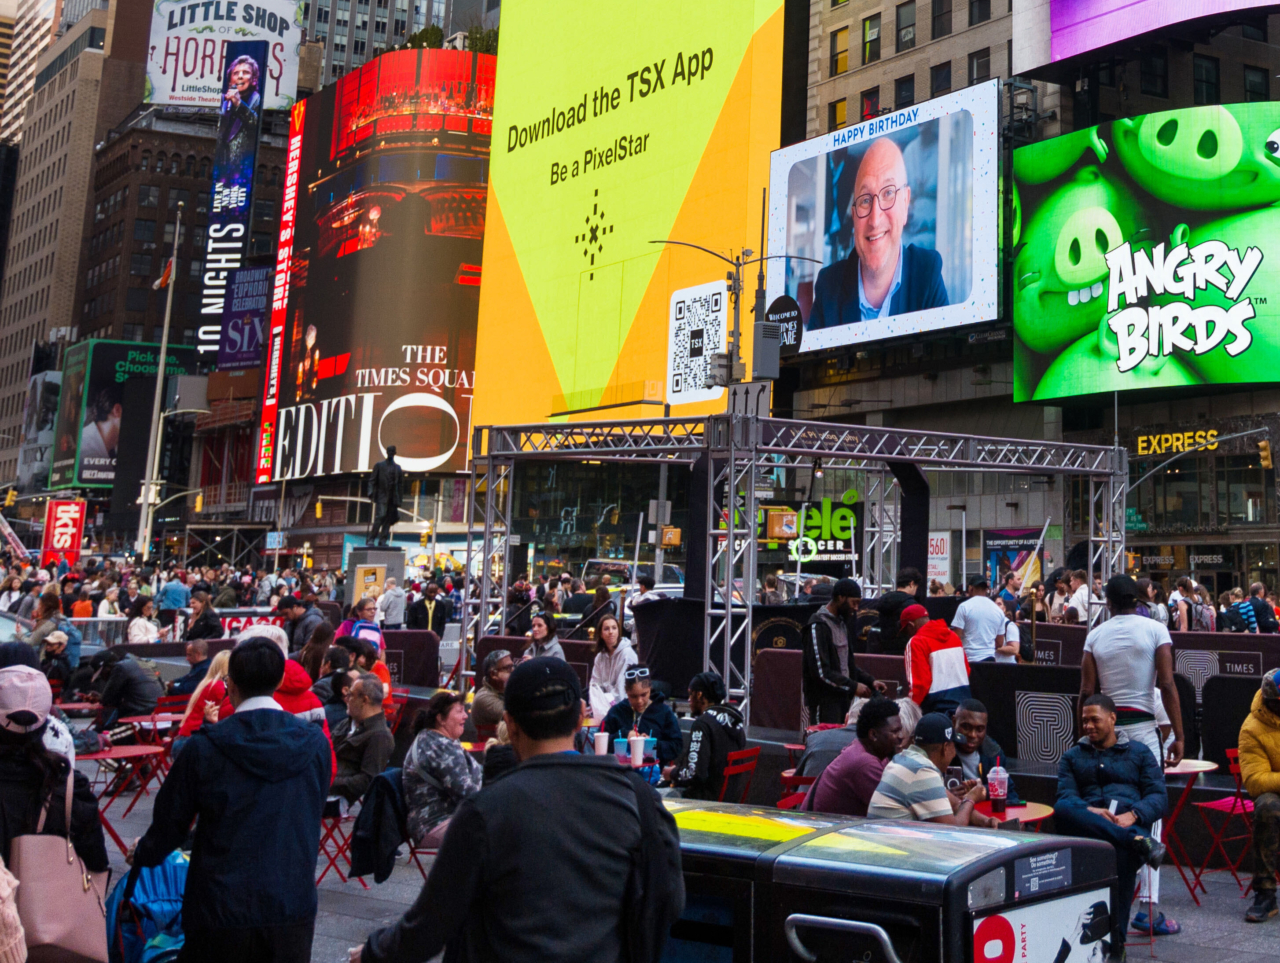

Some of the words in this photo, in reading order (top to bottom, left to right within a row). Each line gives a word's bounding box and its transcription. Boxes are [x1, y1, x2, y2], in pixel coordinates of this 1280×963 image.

[167, 0, 238, 31] LITTLE
[242, 3, 290, 38] SHOP
[219, 26, 232, 34] OF
[507, 93, 587, 154] Download
[592, 86, 621, 118] the
[626, 58, 667, 102] TSX
[672, 47, 714, 86] App
[833, 125, 865, 147] HAPPY
[868, 107, 919, 137] BIRTHDAY
[550, 161, 568, 185] Be
[571, 159, 579, 178] a
[584, 133, 649, 174] PixelStar
[213, 192, 223, 212] LIVE
[229, 185, 239, 208] YORK
[237, 187, 247, 206] CITY
[201, 223, 245, 314] NIGHTS
[273, 246, 292, 312] STORE
[1104, 240, 1264, 313] ANGRY
[197, 325, 222, 354] 10
[691, 338, 703, 349] TSX
[1107, 297, 1256, 373] BIRDS
[128, 351, 154, 362] Pick
[402, 345, 447, 365] THE
[356, 367, 410, 387] TIMES
[1137, 429, 1219, 456] EXPRESS
[53, 504, 80, 549] tkts
[1142, 556, 1174, 564] EXPRESS
[1189, 555, 1223, 564] EXPRESS
[1035, 650, 1054, 660] IMES
[1226, 662, 1254, 673] TIMES
